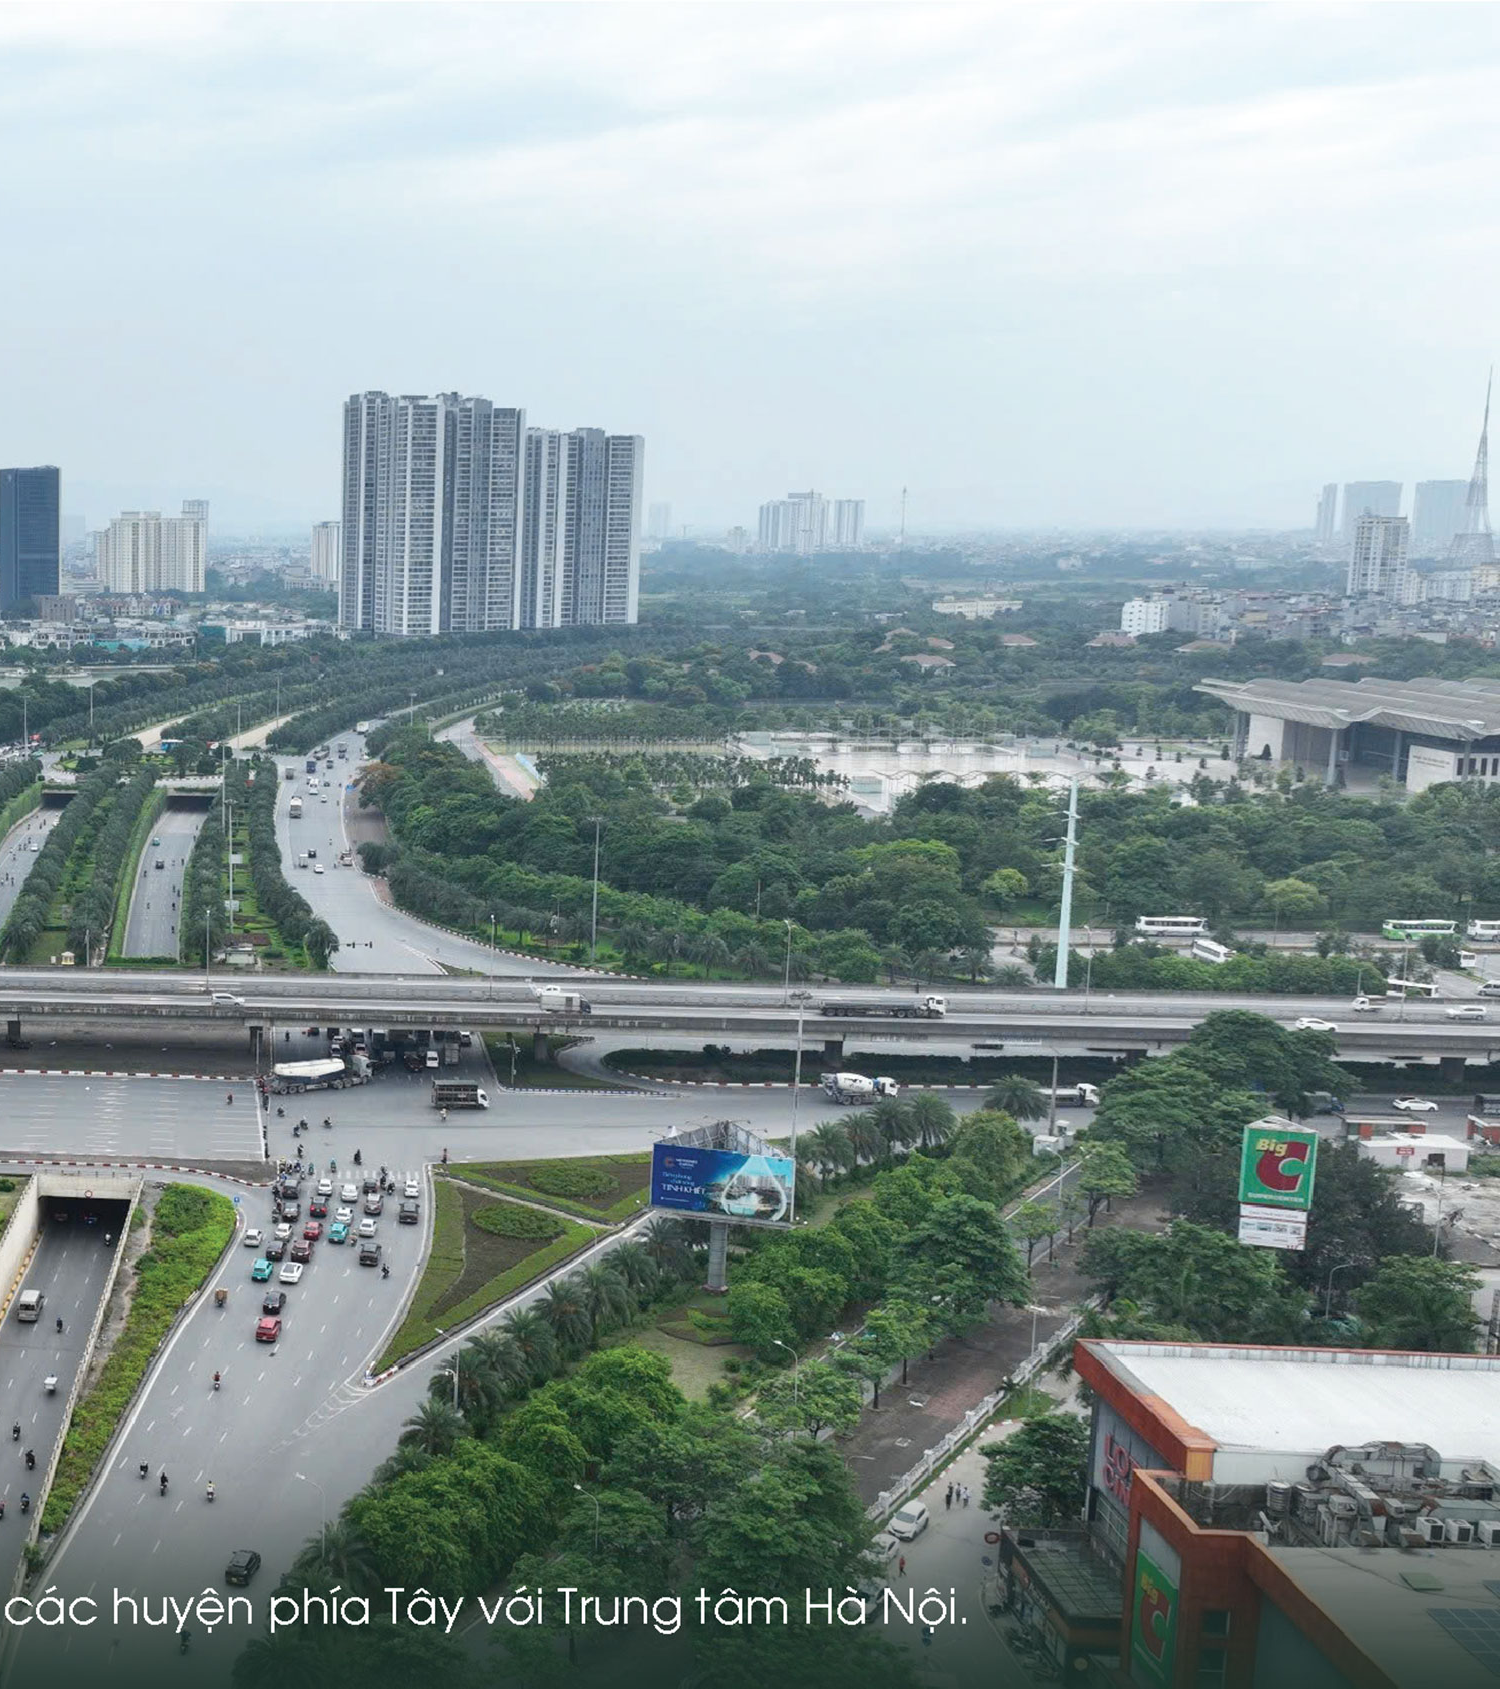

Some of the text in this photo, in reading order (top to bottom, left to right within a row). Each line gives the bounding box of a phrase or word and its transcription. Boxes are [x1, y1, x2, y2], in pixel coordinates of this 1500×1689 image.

[1255, 1138, 1288, 1157] Big
[1255, 1141, 1311, 1193] C
[1141, 1571, 1159, 1606] Big
